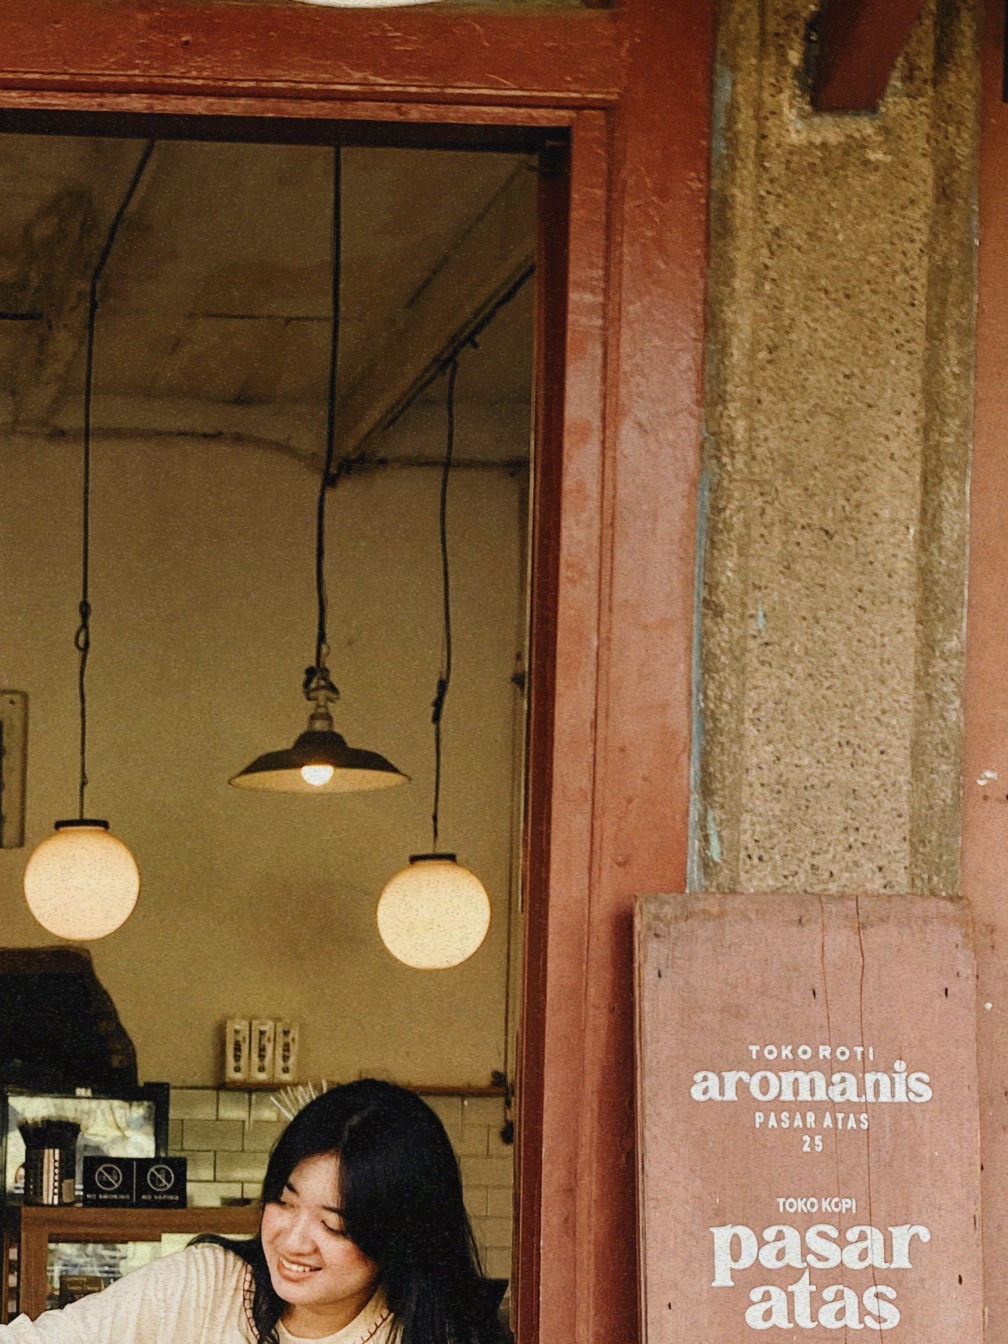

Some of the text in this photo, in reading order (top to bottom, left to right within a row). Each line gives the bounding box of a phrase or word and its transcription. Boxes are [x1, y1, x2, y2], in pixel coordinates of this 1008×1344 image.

[748, 1044, 874, 1061] TOKO ROTI
[690, 1059, 933, 1103] aromanis
[755, 1111, 869, 1130] PASAR ATAS
[802, 1134, 823, 1152] 25
[776, 1197, 857, 1214] TOKO KOPI
[709, 1223, 931, 1287] pasar
[745, 1268, 901, 1330] atas
